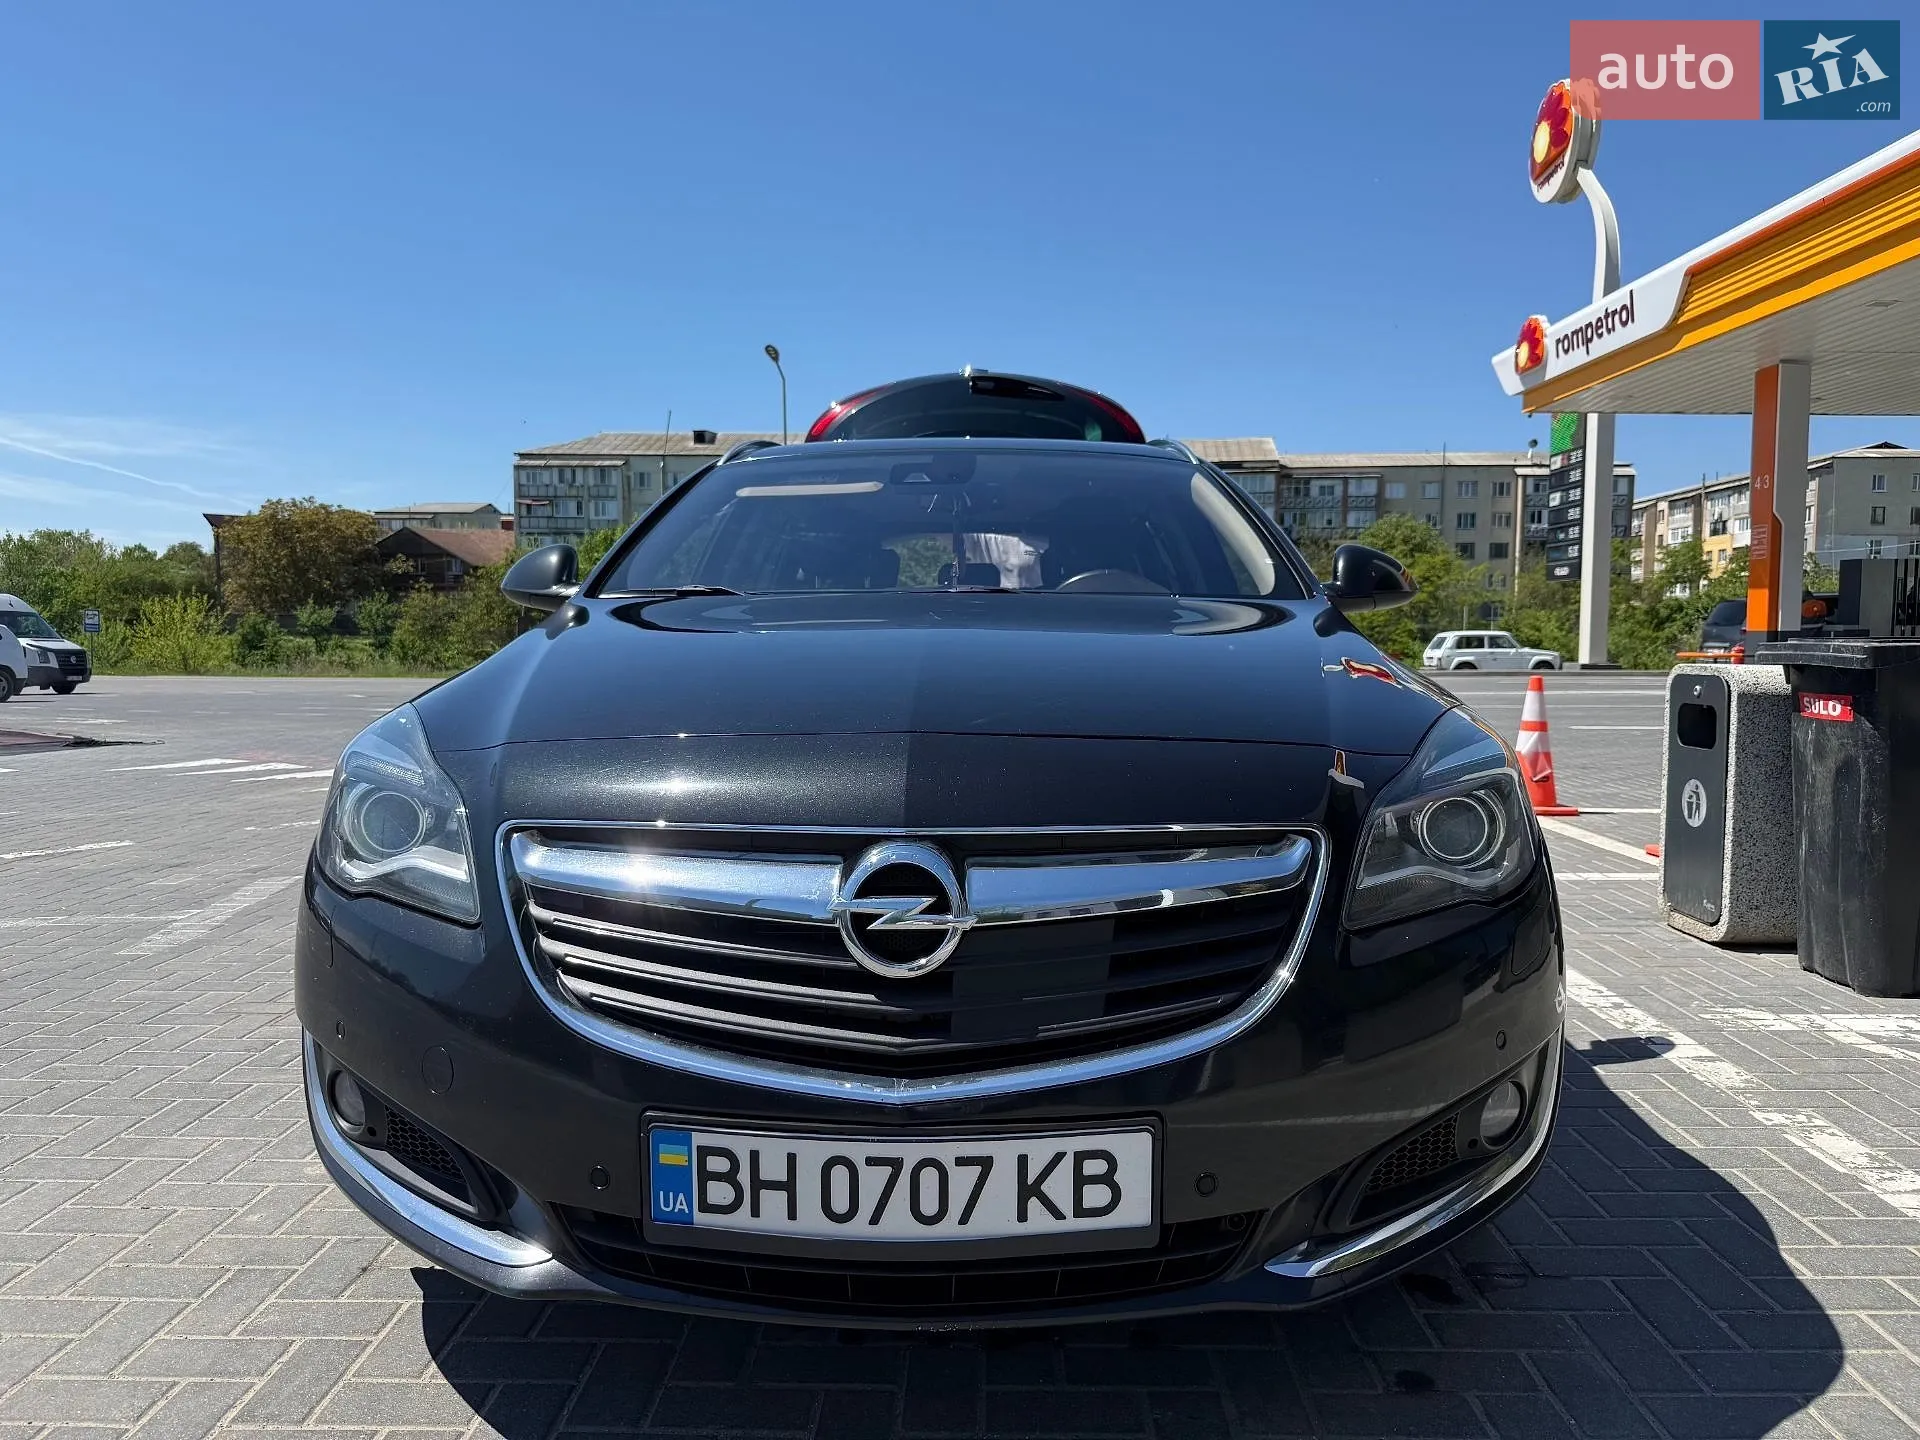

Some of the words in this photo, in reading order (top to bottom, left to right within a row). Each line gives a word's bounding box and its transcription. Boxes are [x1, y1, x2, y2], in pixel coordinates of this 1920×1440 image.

[1554, 290, 1635, 359] rompetrol
[1803, 697, 1842, 716] SULO
[659, 1191, 689, 1214] UA
[696, 1145, 798, 1221] BH
[819, 1155, 994, 1227] 0707
[1016, 1149, 1122, 1223] KB
